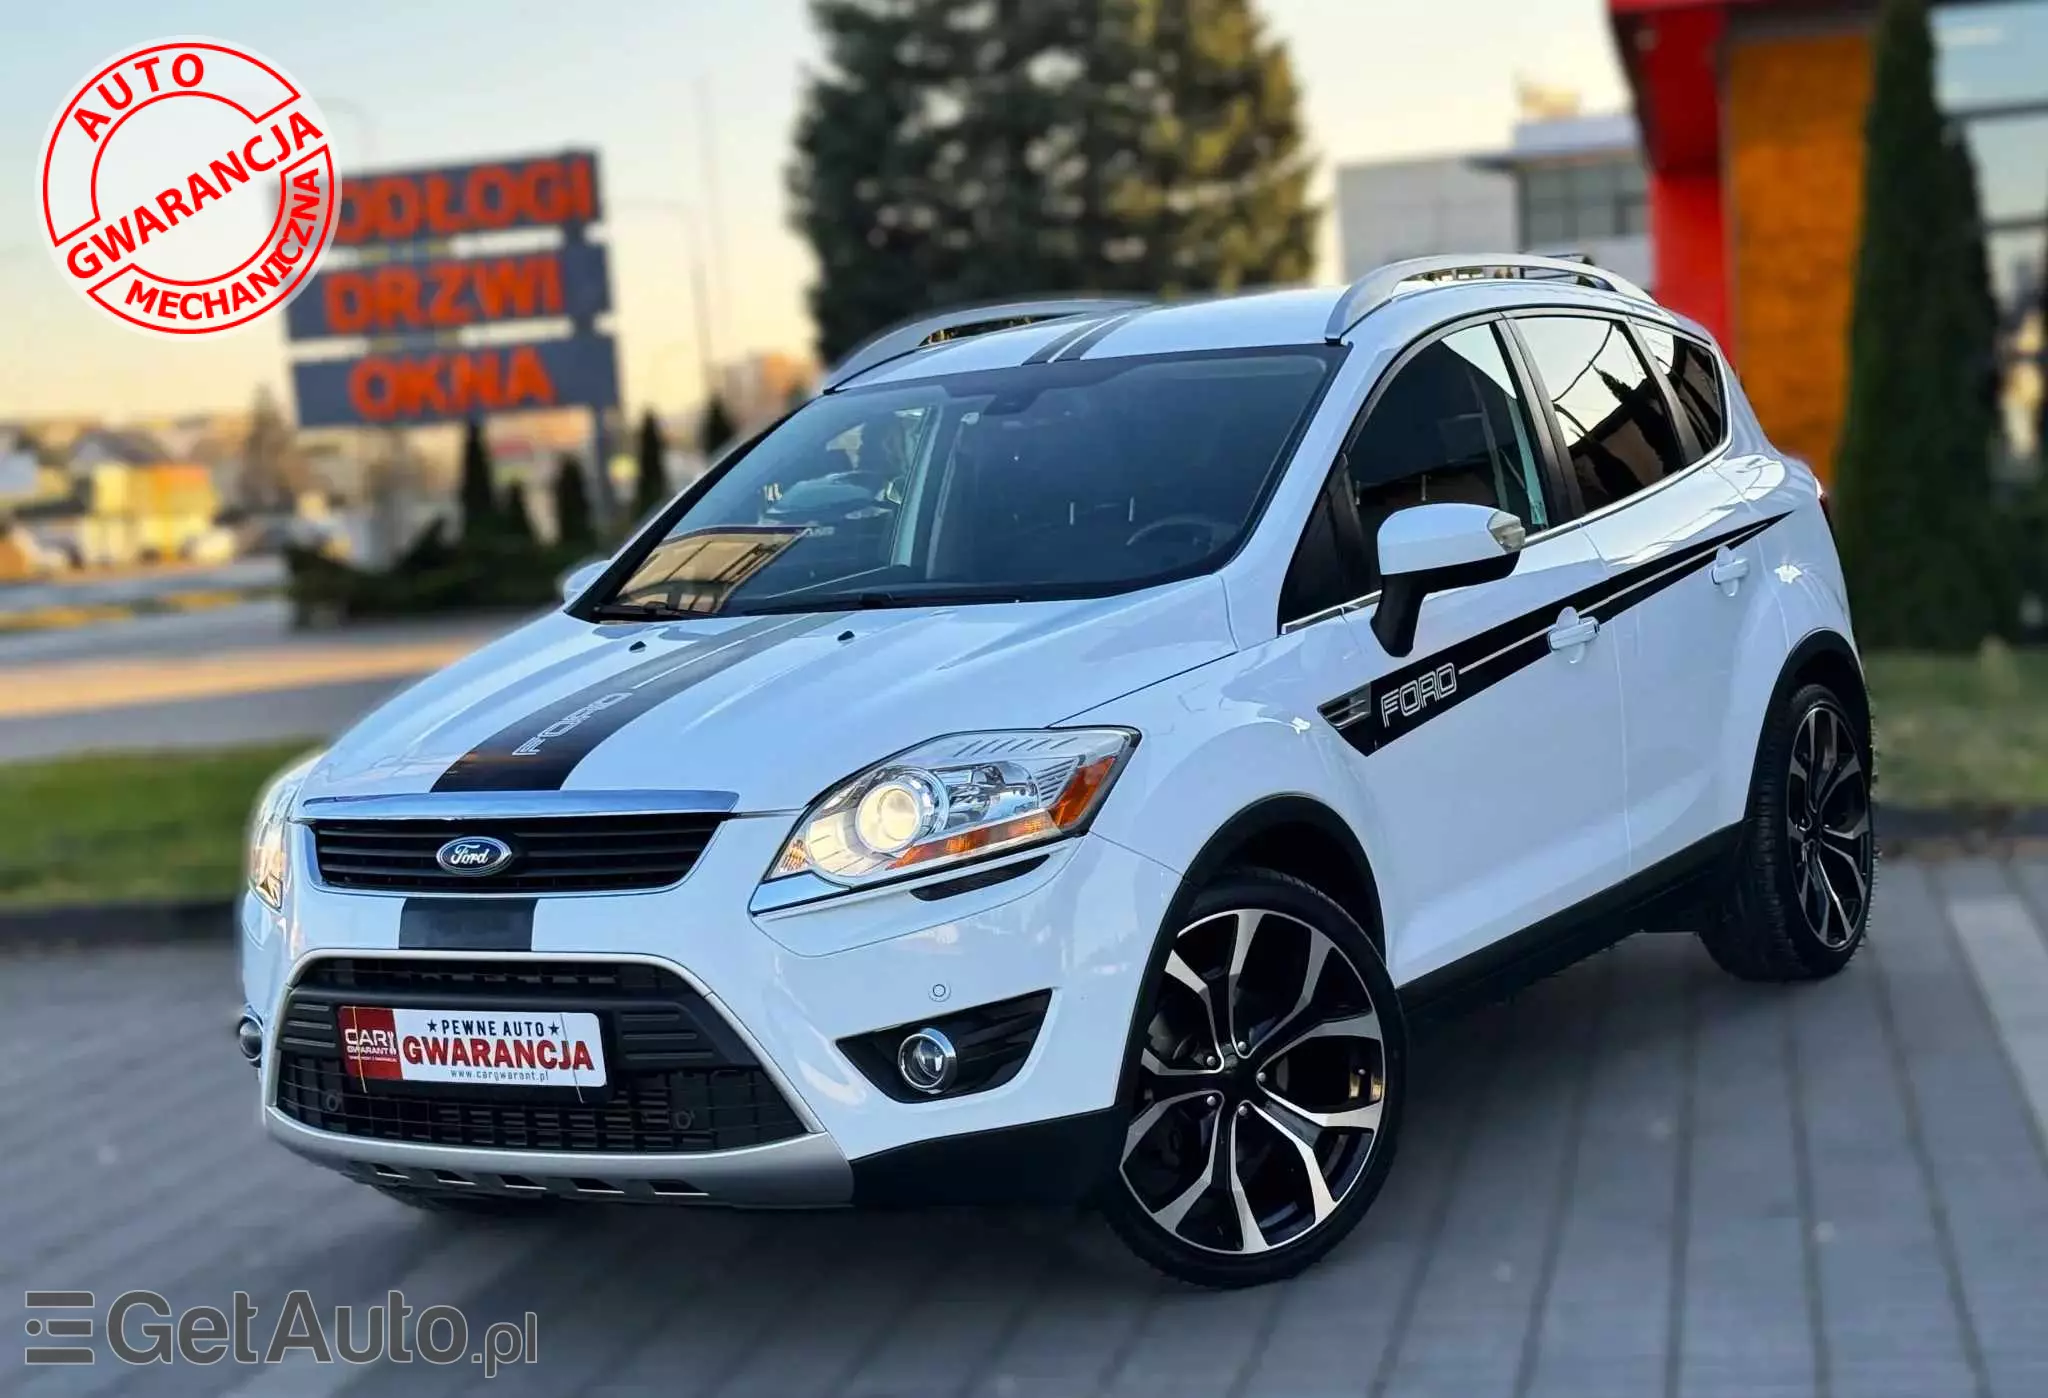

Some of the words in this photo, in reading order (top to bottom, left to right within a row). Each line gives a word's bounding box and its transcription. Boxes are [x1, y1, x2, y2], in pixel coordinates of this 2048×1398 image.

[324, 256, 564, 334] DRZWI
[347, 345, 556, 422] OKNA
[511, 691, 633, 756] FORD
[1380, 662, 1457, 728] FORD
[450, 843, 490, 866] Ford
[401, 1034, 596, 1071] GWARANCJA
[441, 1019, 497, 1037] PEWNE
[503, 1021, 544, 1037] AUTO
